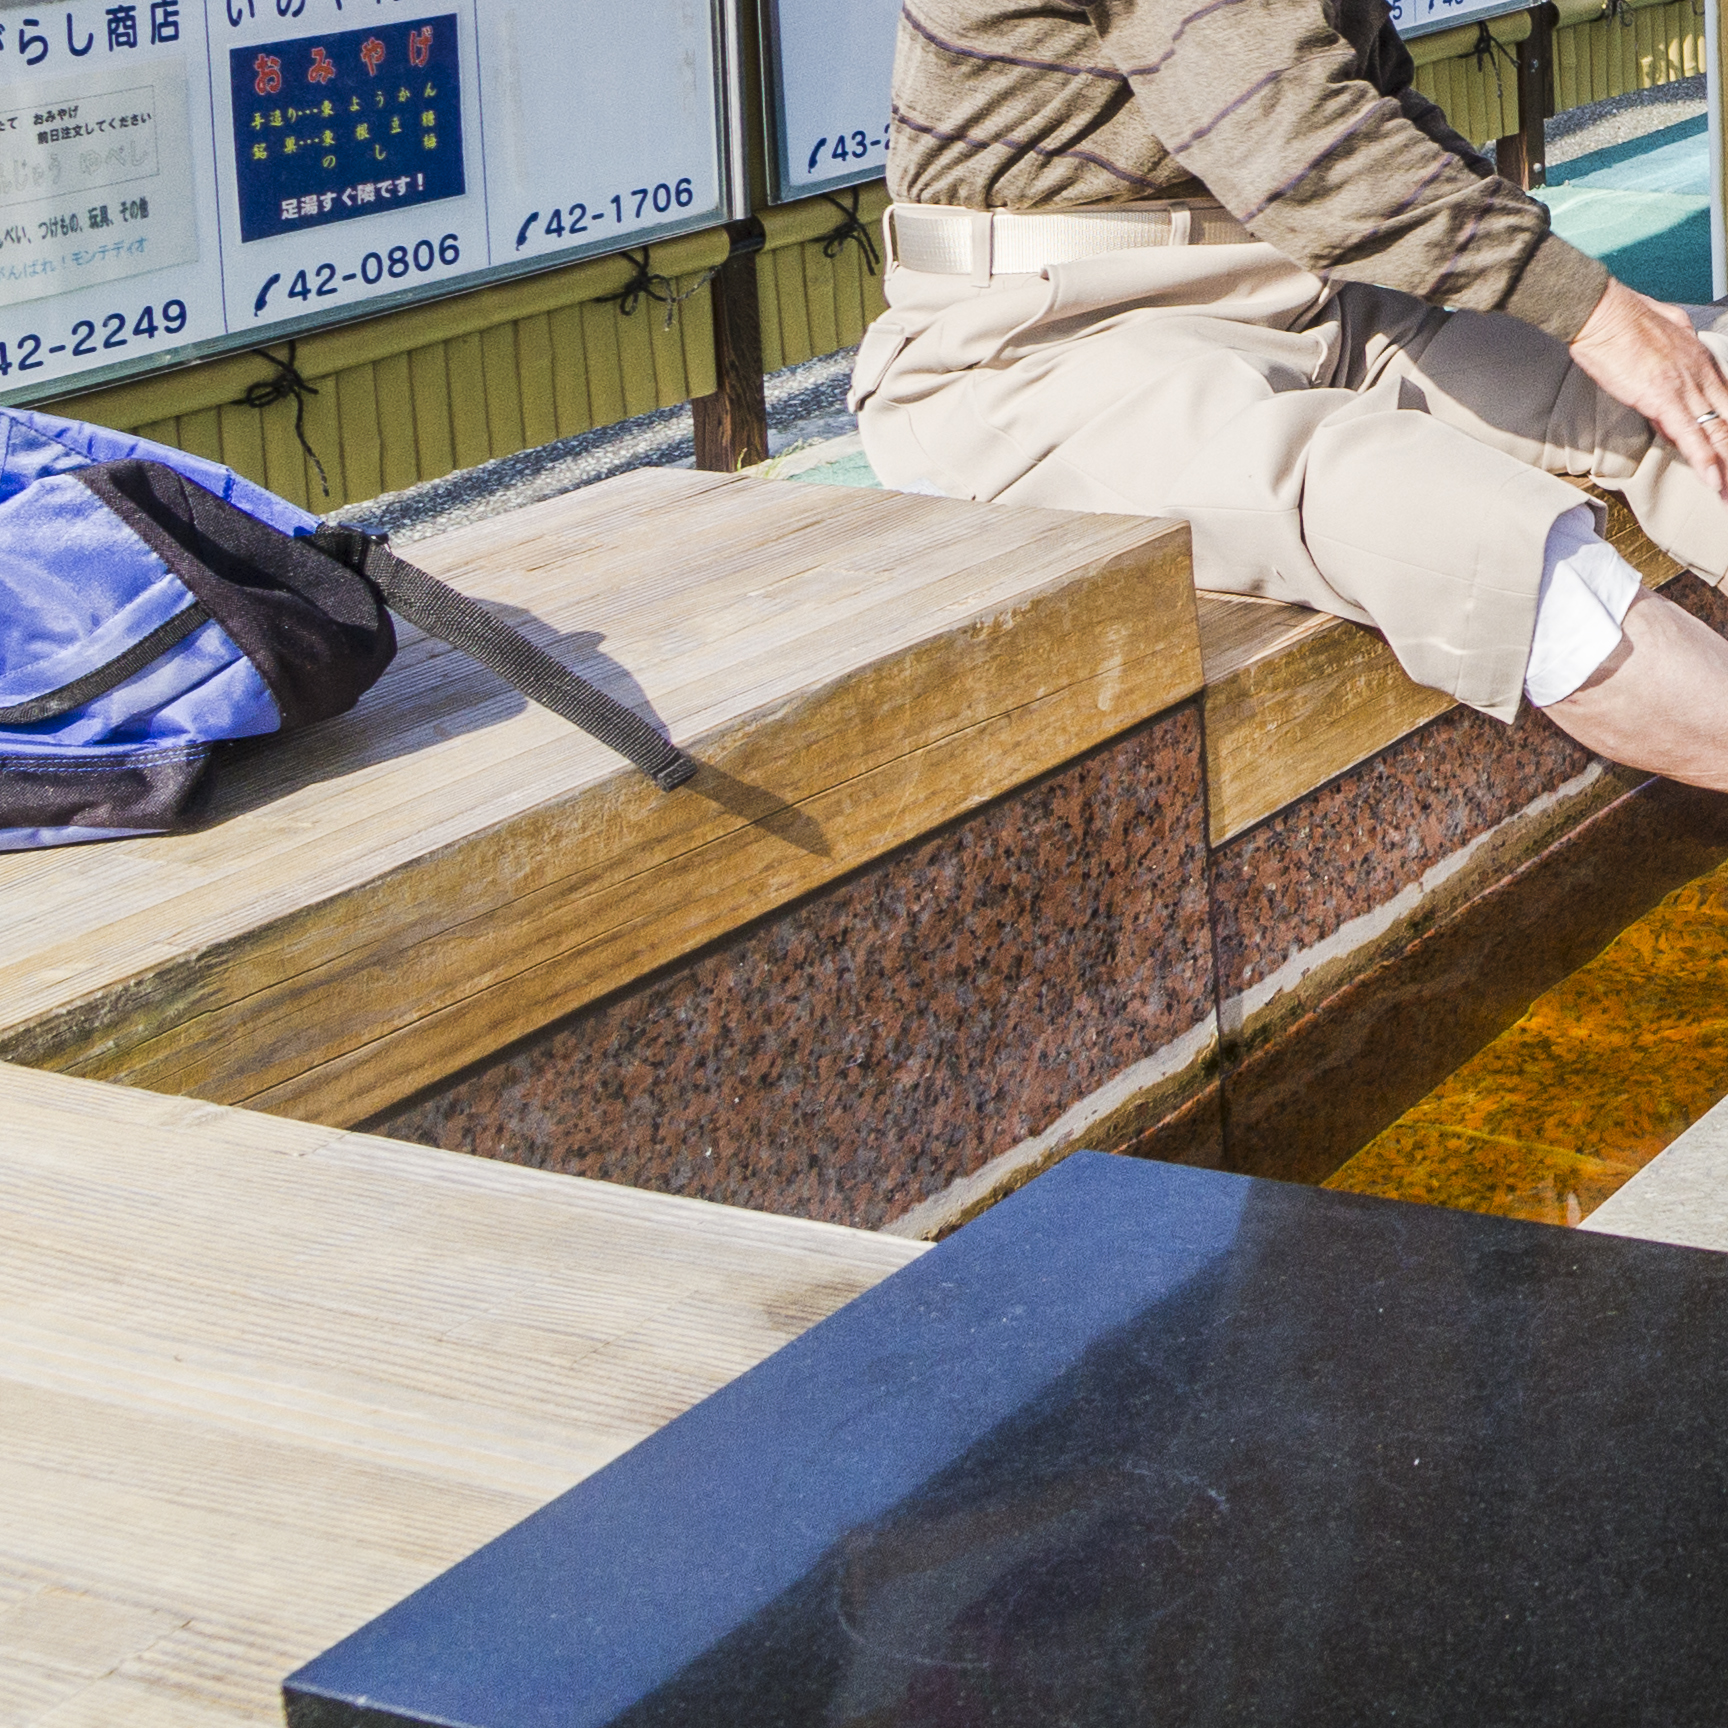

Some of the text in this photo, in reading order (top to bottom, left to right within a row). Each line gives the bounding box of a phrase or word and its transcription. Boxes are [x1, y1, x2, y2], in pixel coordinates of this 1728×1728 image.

[254, 25, 434, 96] おみやげ
[33, 105, 80, 126] おみやげ
[37, 112, 153, 145] 前日注文してください
[544, 177, 695, 239] 42-1706
[0, 235, 148, 281] んばれ！モンテディオ
[287, 233, 462, 303] 42-0806
